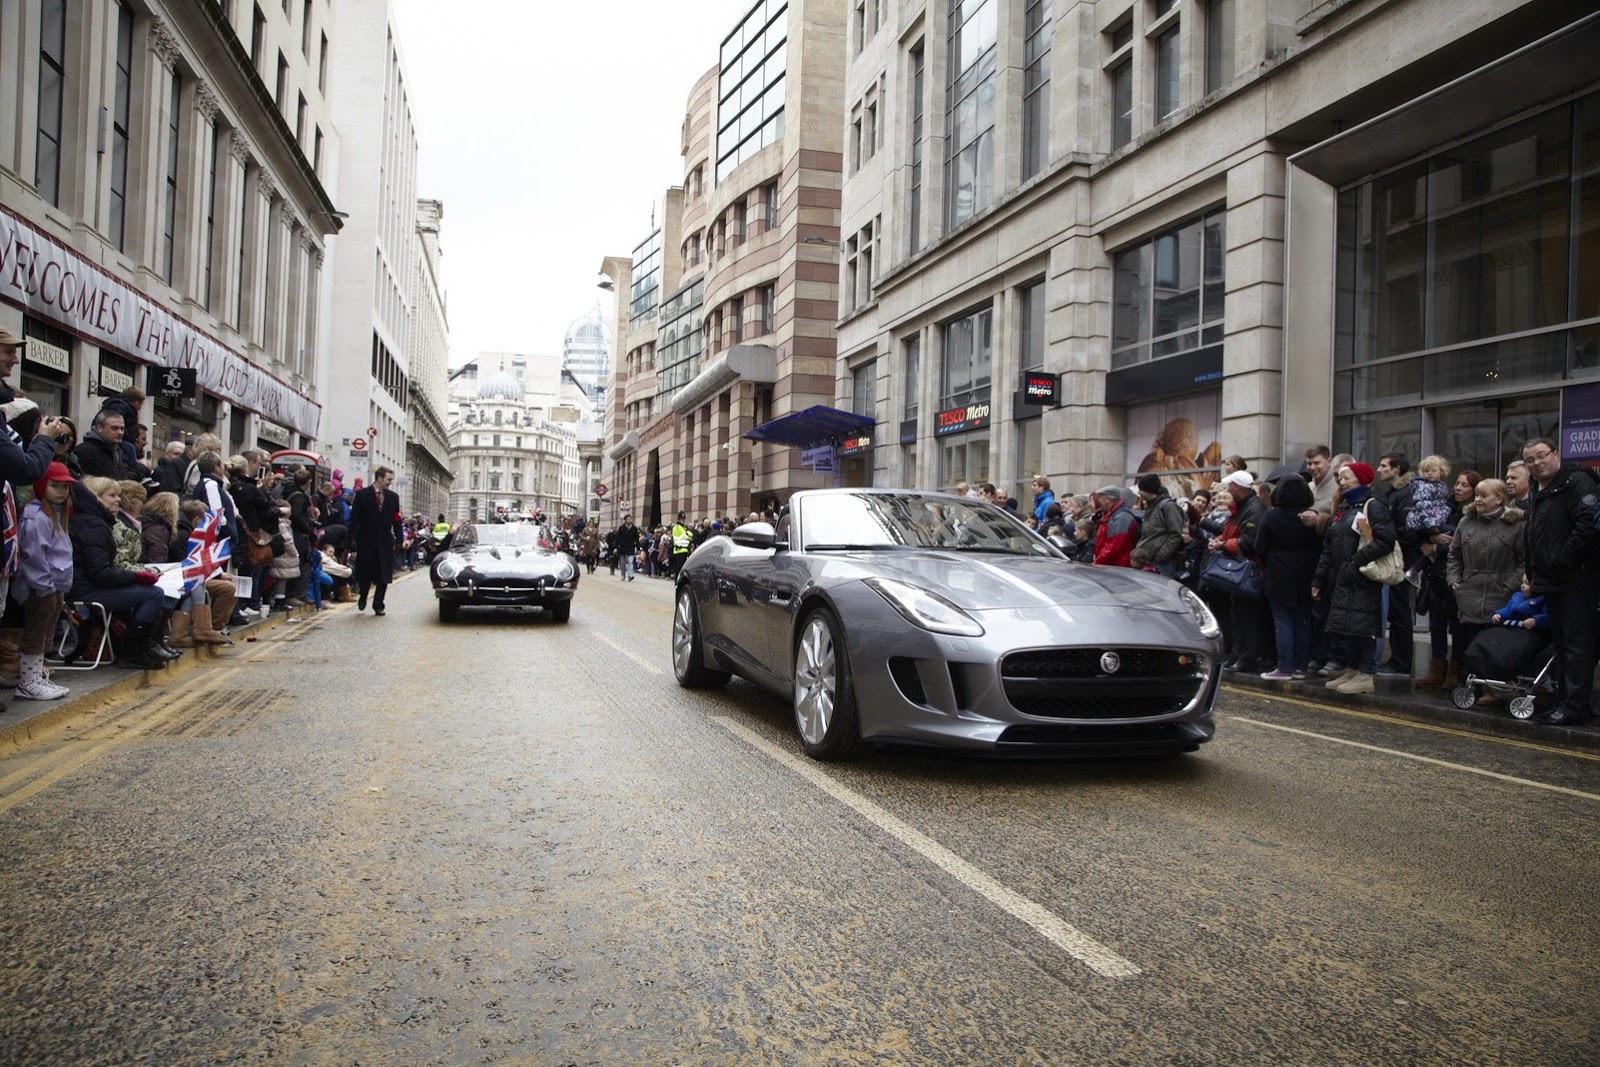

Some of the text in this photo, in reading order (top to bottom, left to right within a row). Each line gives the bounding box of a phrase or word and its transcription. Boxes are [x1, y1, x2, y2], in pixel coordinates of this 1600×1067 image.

[135, 306, 170, 360] THE
[30, 341, 65, 369] BARKER
[104, 370, 130, 391] BARKER
[1028, 378, 1053, 386] TESCO
[1028, 387, 1052, 395] Metro
[939, 404, 989, 426] TESCO Metro
[844, 438, 858, 449] TESCO
